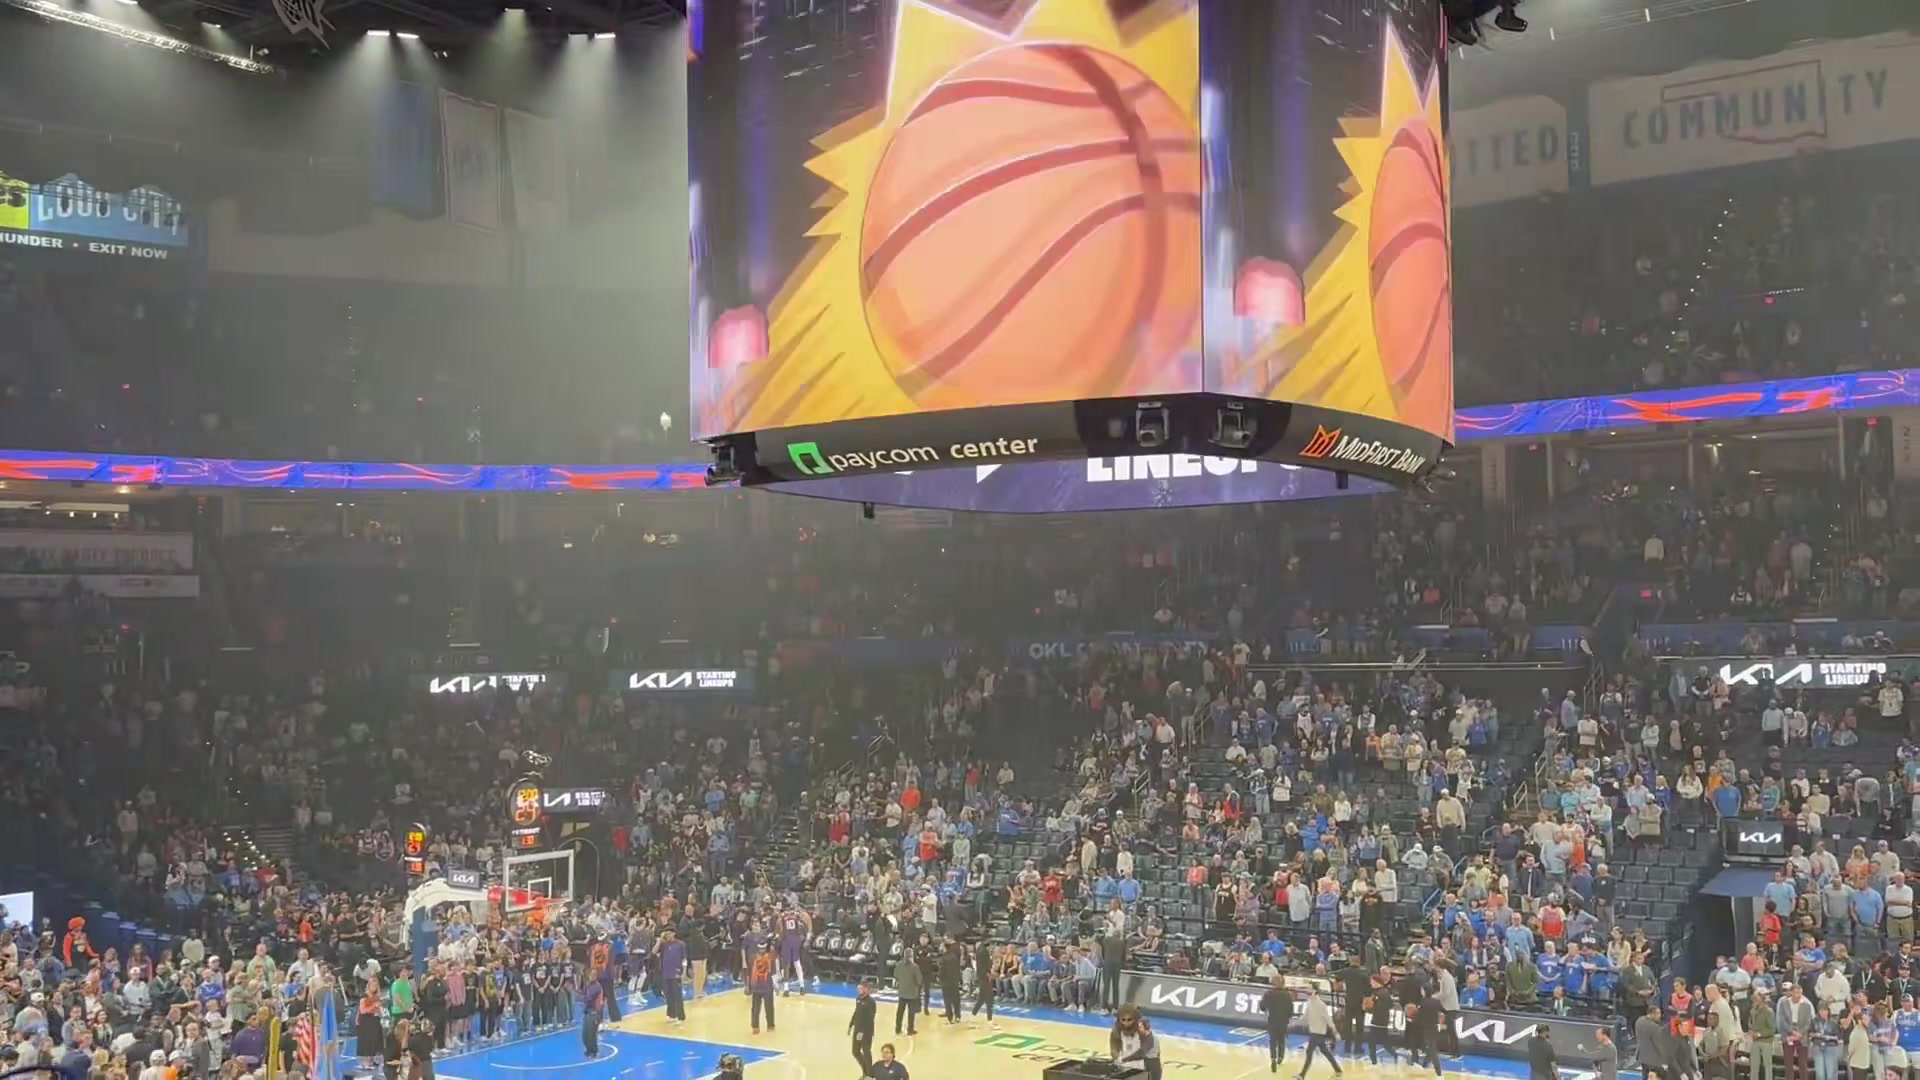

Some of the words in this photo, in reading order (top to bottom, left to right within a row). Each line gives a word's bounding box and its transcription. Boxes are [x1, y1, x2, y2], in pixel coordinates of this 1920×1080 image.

[1622, 67, 1889, 148] COMMUNITY
[1452, 124, 1560, 177] ITED
[88, 242, 126, 256] EXIT
[131, 246, 168, 260] NOW
[828, 444, 940, 471] paycom
[949, 437, 1039, 460] center
[629, 671, 693, 689] KIA
[696, 670, 737, 680] STARTING
[1719, 663, 1813, 686] KIA
[1819, 662, 1887, 674] STARTING
[1739, 831, 1782, 844] KIA
[453, 873, 475, 884] KIA
[1151, 983, 1226, 1012] KIA
